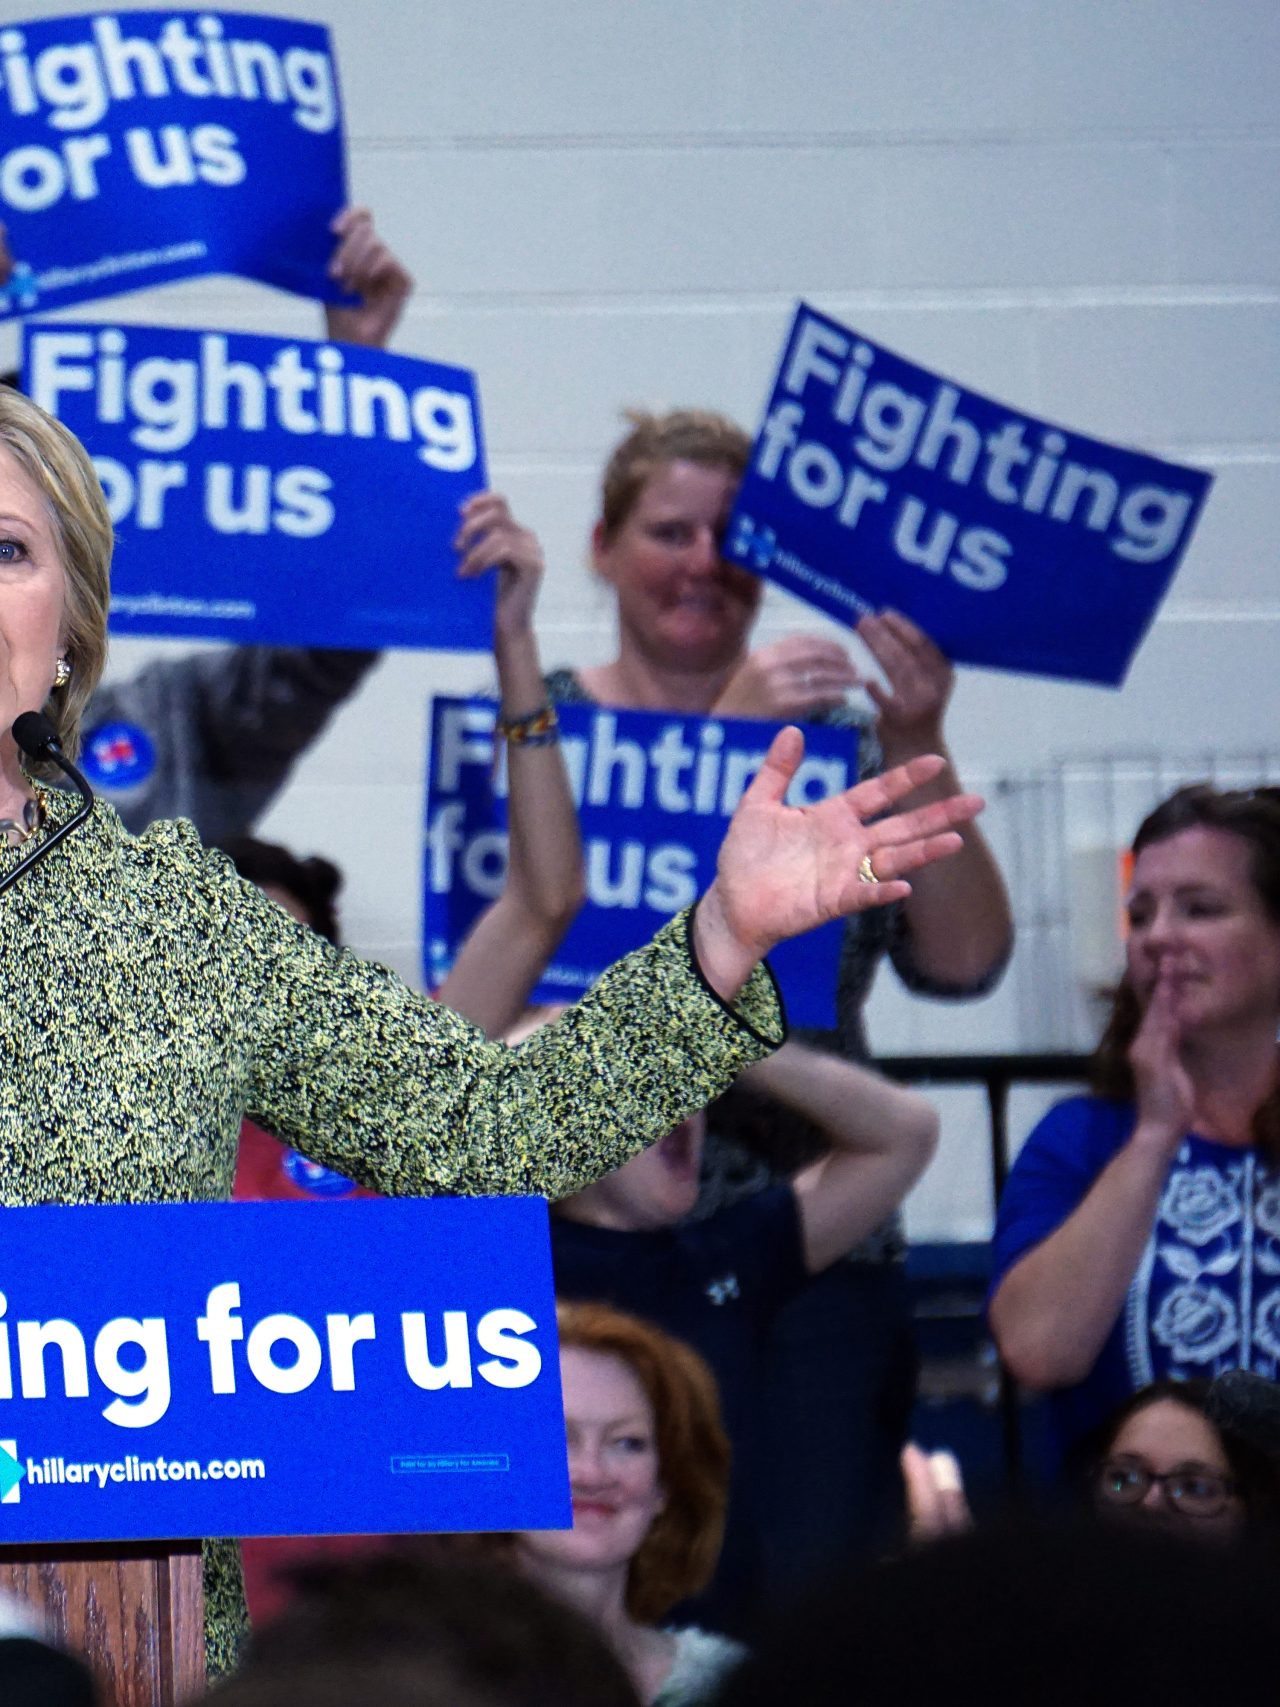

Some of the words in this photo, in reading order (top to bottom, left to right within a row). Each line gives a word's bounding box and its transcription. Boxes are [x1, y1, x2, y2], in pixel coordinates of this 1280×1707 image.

[125, 122, 247, 188] us
[30, 329, 477, 472] Fighting
[782, 316, 1194, 563] Fighting
[95, 455, 187, 529] or
[204, 462, 336, 538] us
[755, 403, 887, 528] for
[893, 495, 1014, 591] us
[426, 803, 510, 896] fo
[586, 838, 699, 915] us
[197, 1281, 377, 1395] for
[401, 1306, 543, 1391] us
[26, 1455, 266, 1489] hillaryclinton.com
